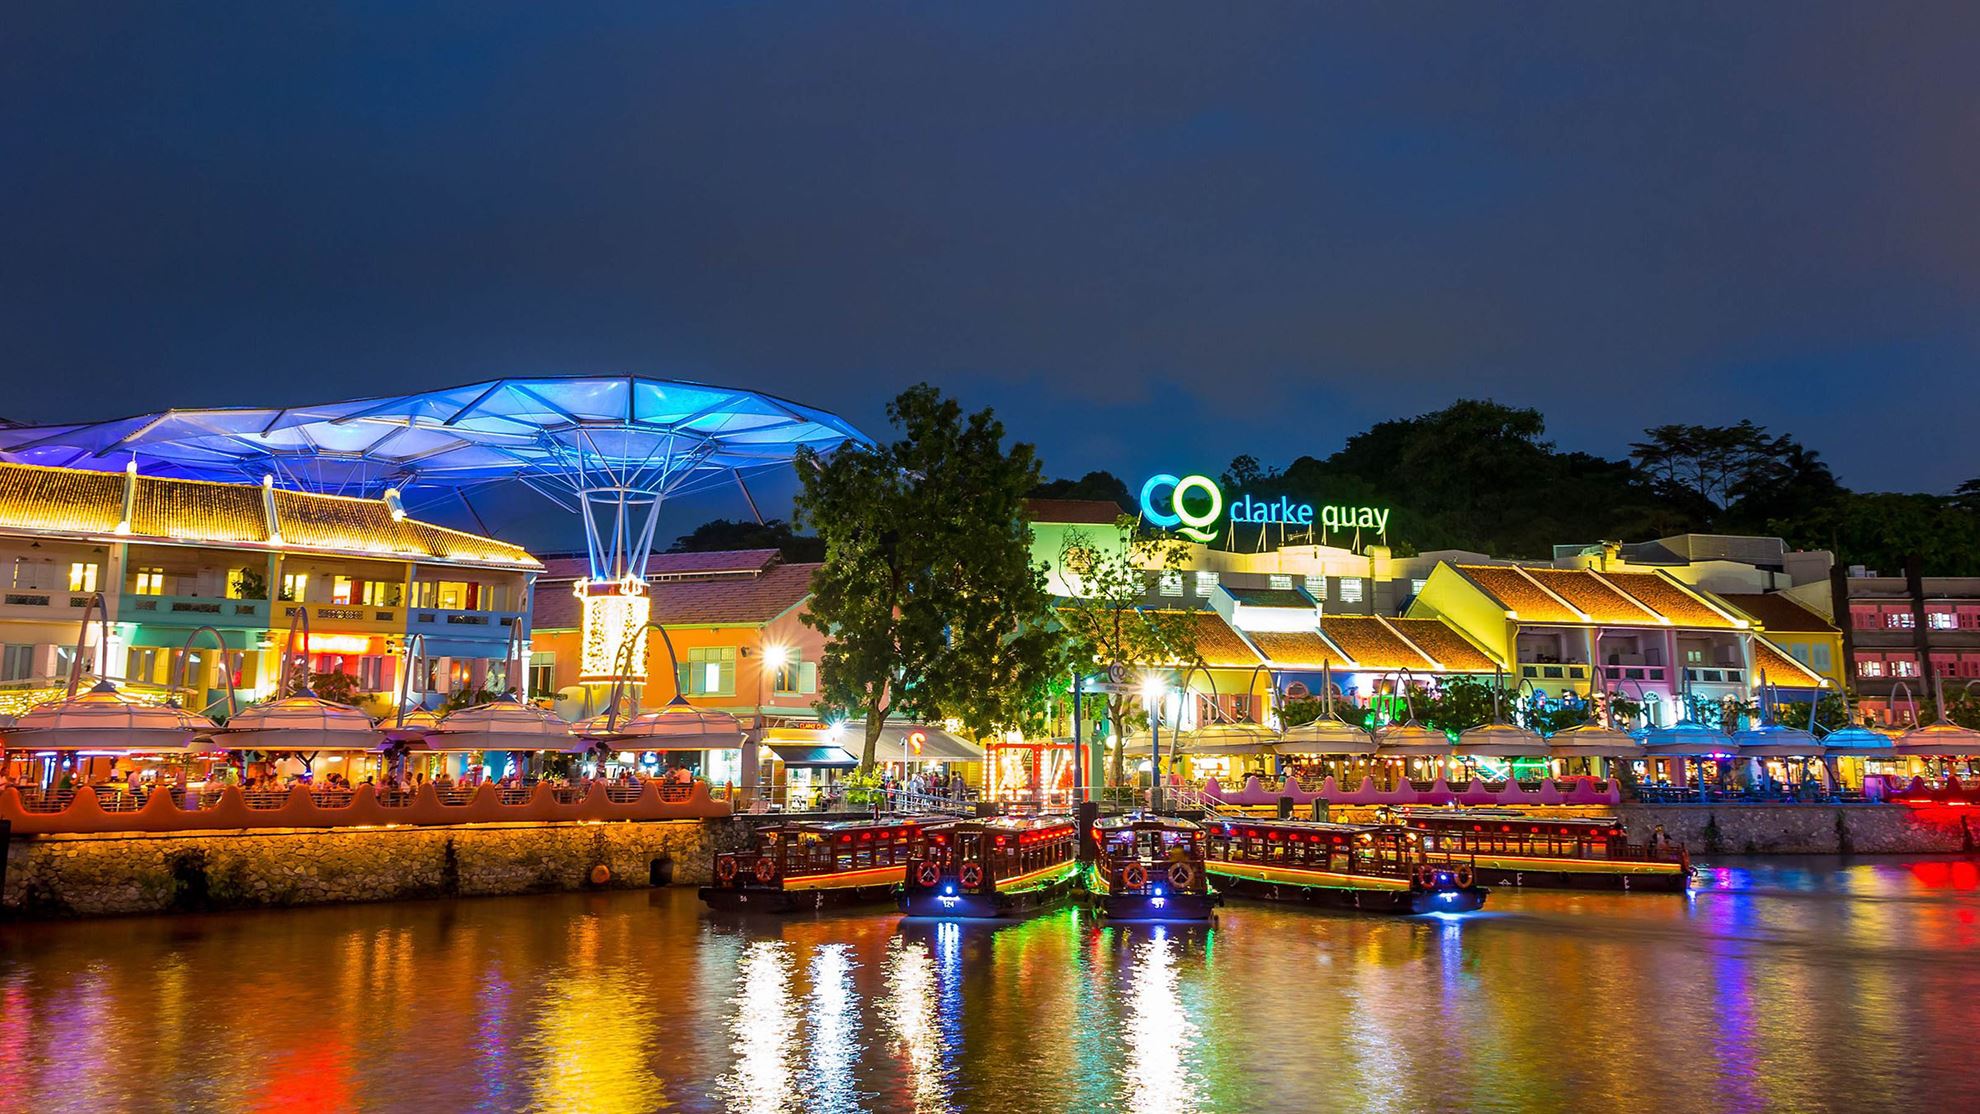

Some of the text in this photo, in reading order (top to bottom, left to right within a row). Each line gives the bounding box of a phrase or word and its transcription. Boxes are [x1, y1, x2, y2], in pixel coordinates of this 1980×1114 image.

[1140, 474, 1390, 542] CQ clarke quay
